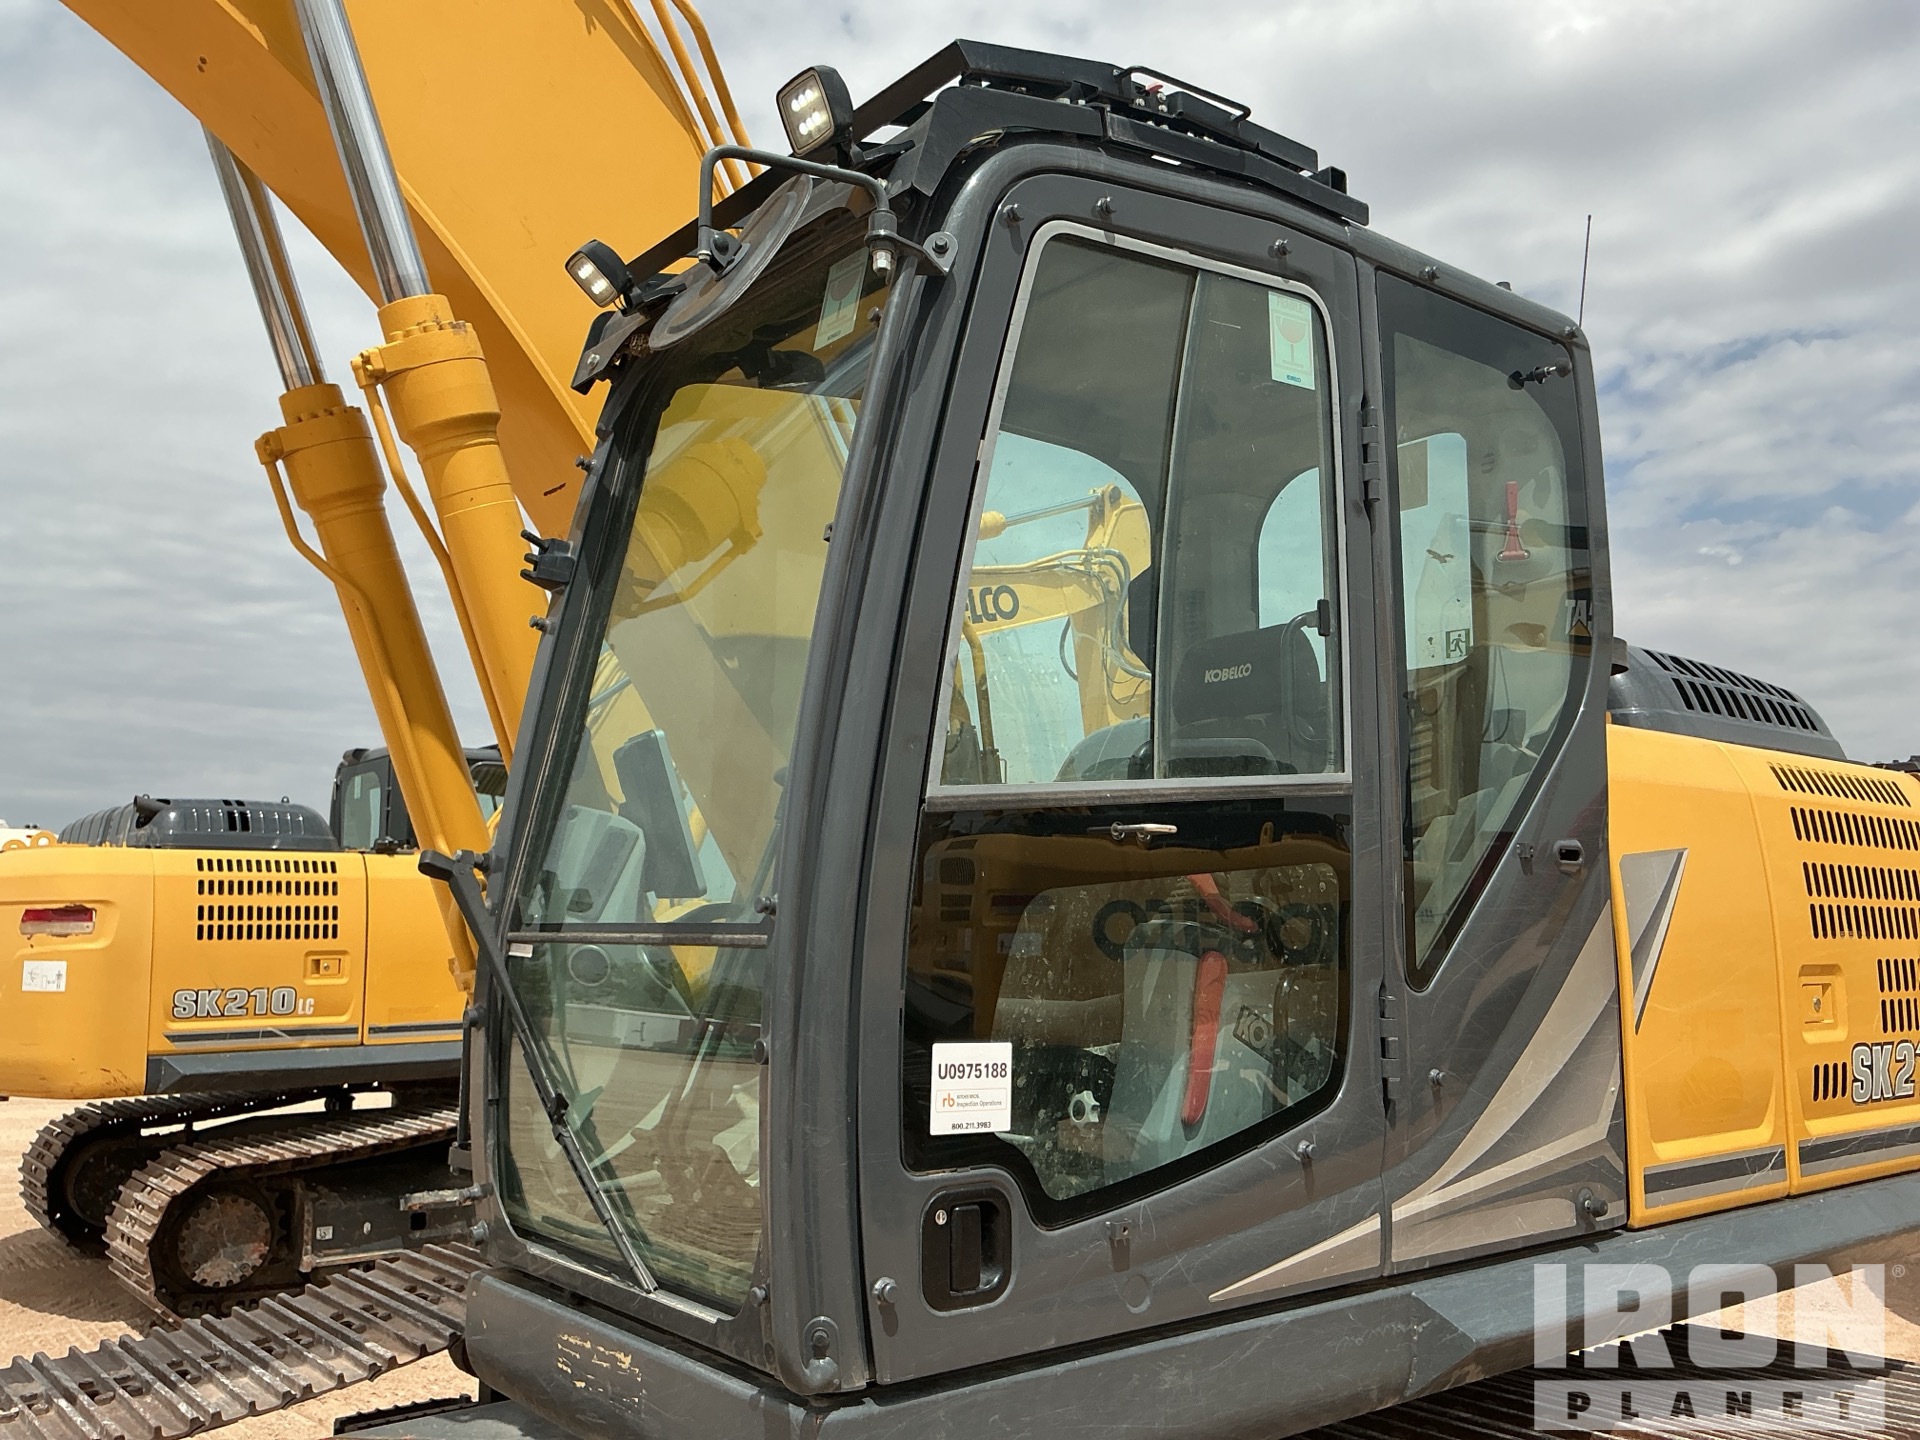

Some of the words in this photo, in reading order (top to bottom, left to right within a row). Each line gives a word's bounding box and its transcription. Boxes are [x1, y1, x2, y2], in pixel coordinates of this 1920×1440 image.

[1204, 663, 1252, 684] KOBELCO
[172, 986, 297, 1019] SK210
[938, 1063, 1007, 1080] U0975188
[1851, 1039, 1920, 1105] SK2
[942, 1093, 955, 1107] rb
[957, 1101, 979, 1109] Inspection
[979, 1100, 1002, 1108] Operations
[951, 1121, 992, 1130] 800.211.3983
